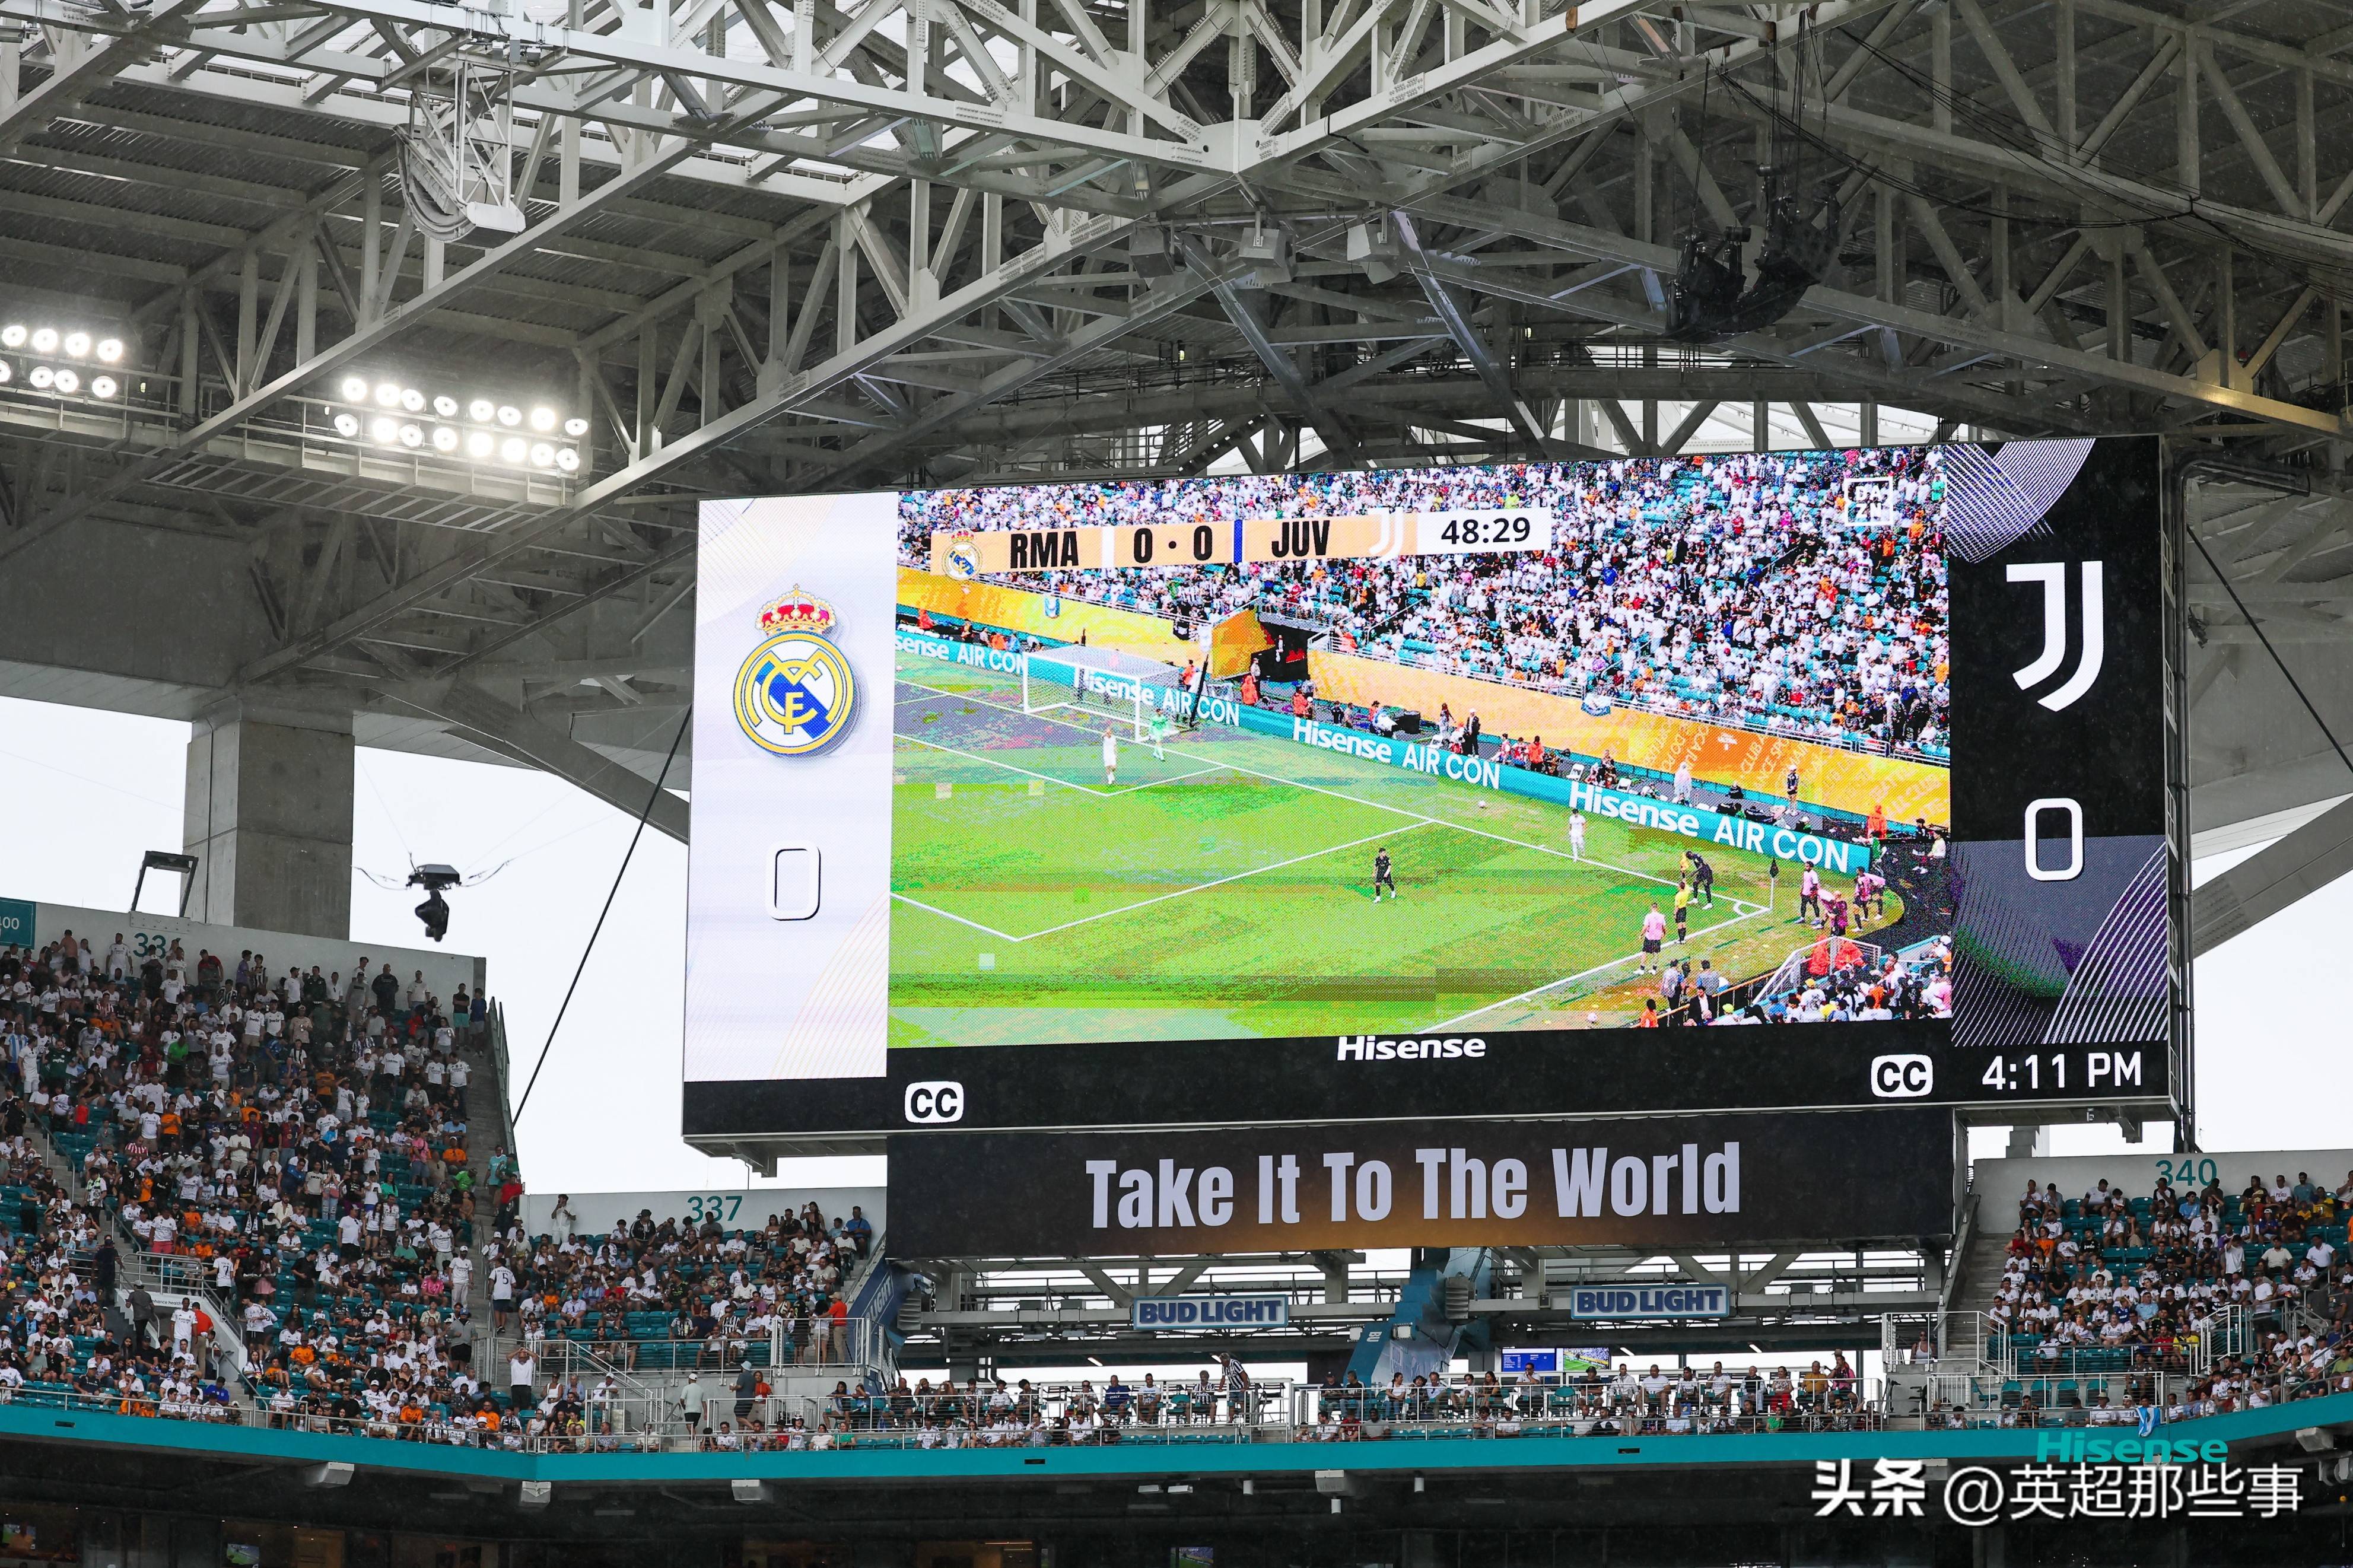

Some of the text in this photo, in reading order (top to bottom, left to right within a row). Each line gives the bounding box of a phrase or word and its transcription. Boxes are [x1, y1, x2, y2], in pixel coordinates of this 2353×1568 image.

[1010, 517, 1531, 568] RMA 0 0 JUV 48:29
[957, 643, 985, 669] AIR
[1163, 688, 1193, 715] AIR
[1197, 695, 1240, 727] CON
[1293, 717, 1500, 790] Hisense AIR CON
[1569, 780, 1849, 873] Hisense AIR CON
[2024, 797, 2084, 881] 0
[766, 840, 821, 921] 0
[0, 916, 20, 930] 00
[133, 933, 181, 959] 33
[1337, 1036, 1486, 1061] Hisense
[1877, 1061, 1926, 1093] CC
[1982, 1052, 2141, 1090] 4:11 PM
[910, 1088, 958, 1118] CC
[1086, 1141, 1740, 1228] Take It To The World
[2155, 1159, 2217, 1187] 340
[687, 1196, 743, 1223] 337
[503, 1273, 508, 1284] 5
[1140, 1300, 1282, 1324] BUD LIGHT
[1577, 1289, 1724, 1313] BUD LIGHT
